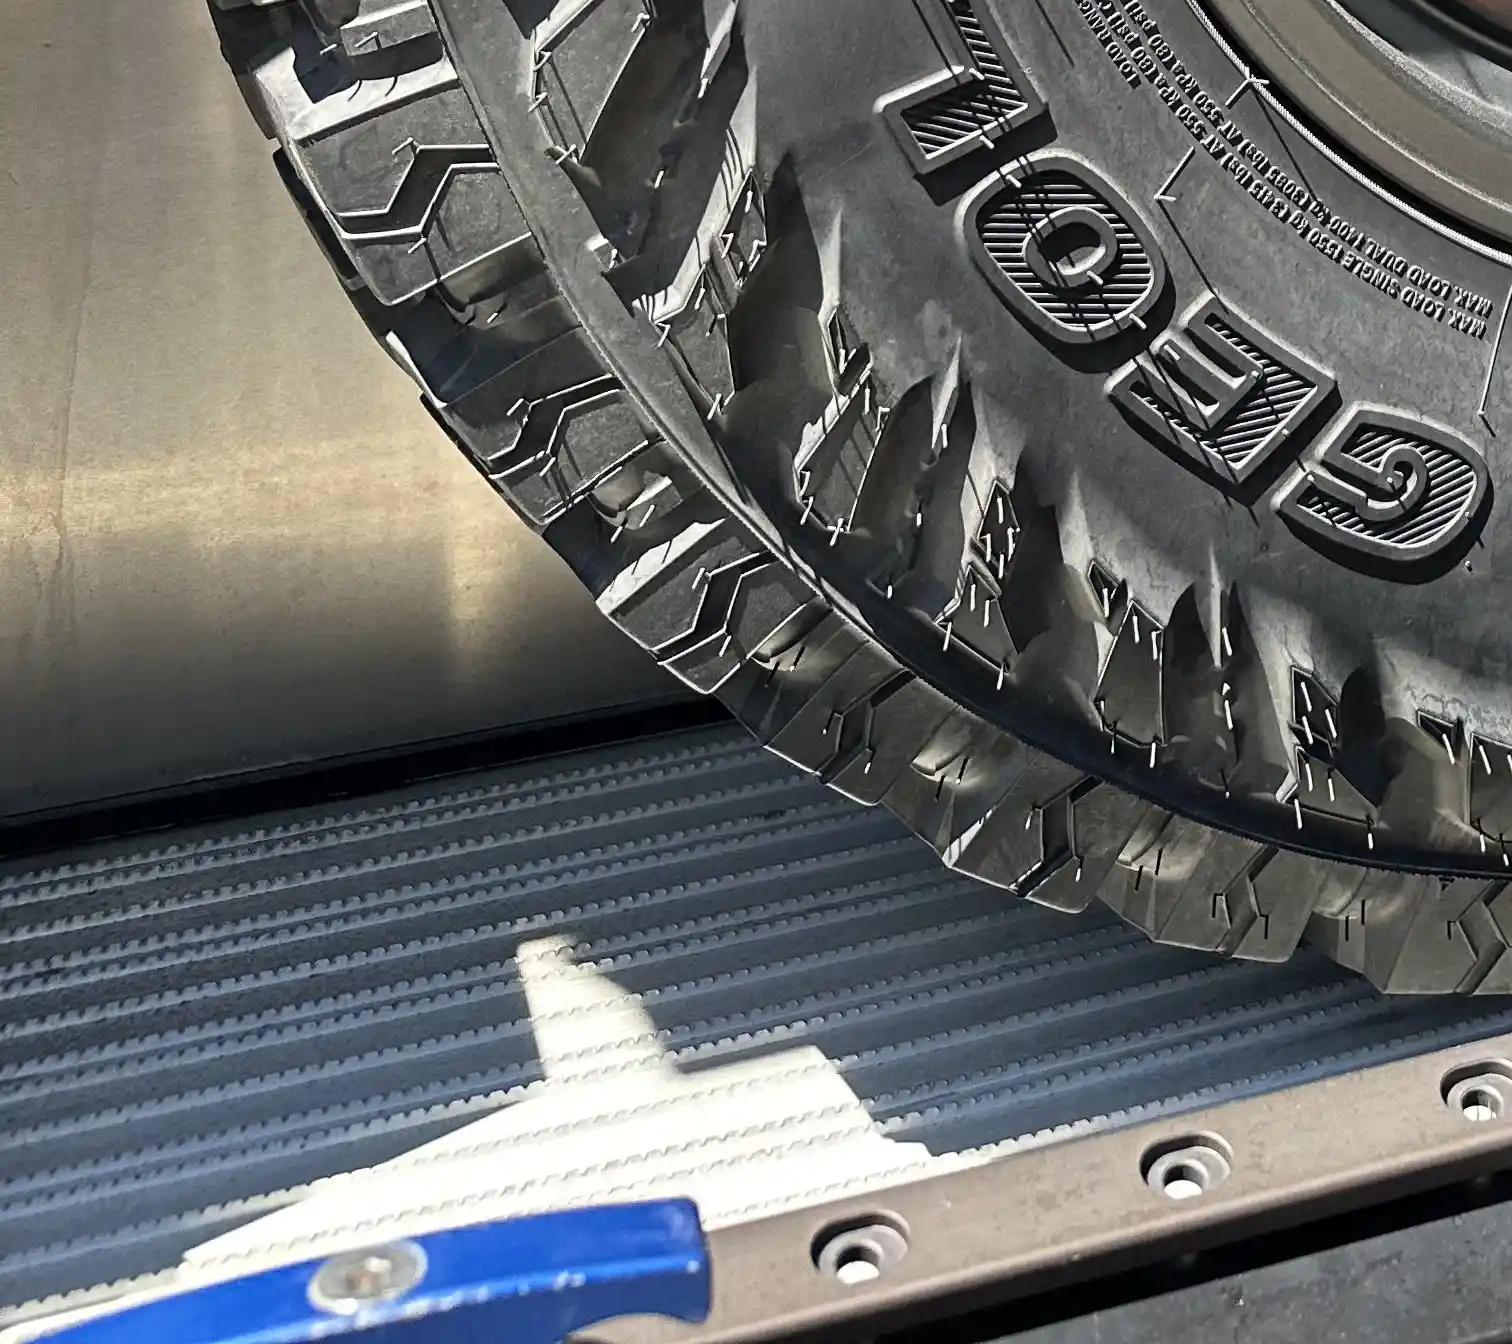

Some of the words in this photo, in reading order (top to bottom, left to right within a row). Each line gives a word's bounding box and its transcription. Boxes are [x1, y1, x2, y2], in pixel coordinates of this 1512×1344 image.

[1105, 41, 1138, 84] LOAD
[1130, 43, 1156, 78] (80
[1147, 31, 1174, 65] (80
[1150, 72, 1180, 108] kPa
[1168, 59, 1197, 95] kPa
[1175, 103, 1203, 136] 550
[1192, 90, 1221, 122] 550
[1200, 133, 1224, 157] AT
[1219, 120, 1241, 145] AT
[1287, 209, 1308, 236] kg
[1306, 227, 1342, 261] 1550
[1365, 237, 1407, 277] DUAL
[1341, 251, 1400, 298] SINGLE
[1406, 264, 1451, 300] LOAD
[1400, 286, 1445, 321] LOAD
[1453, 286, 1492, 318] MAX.
[1447, 307, 1486, 340] MAX.
